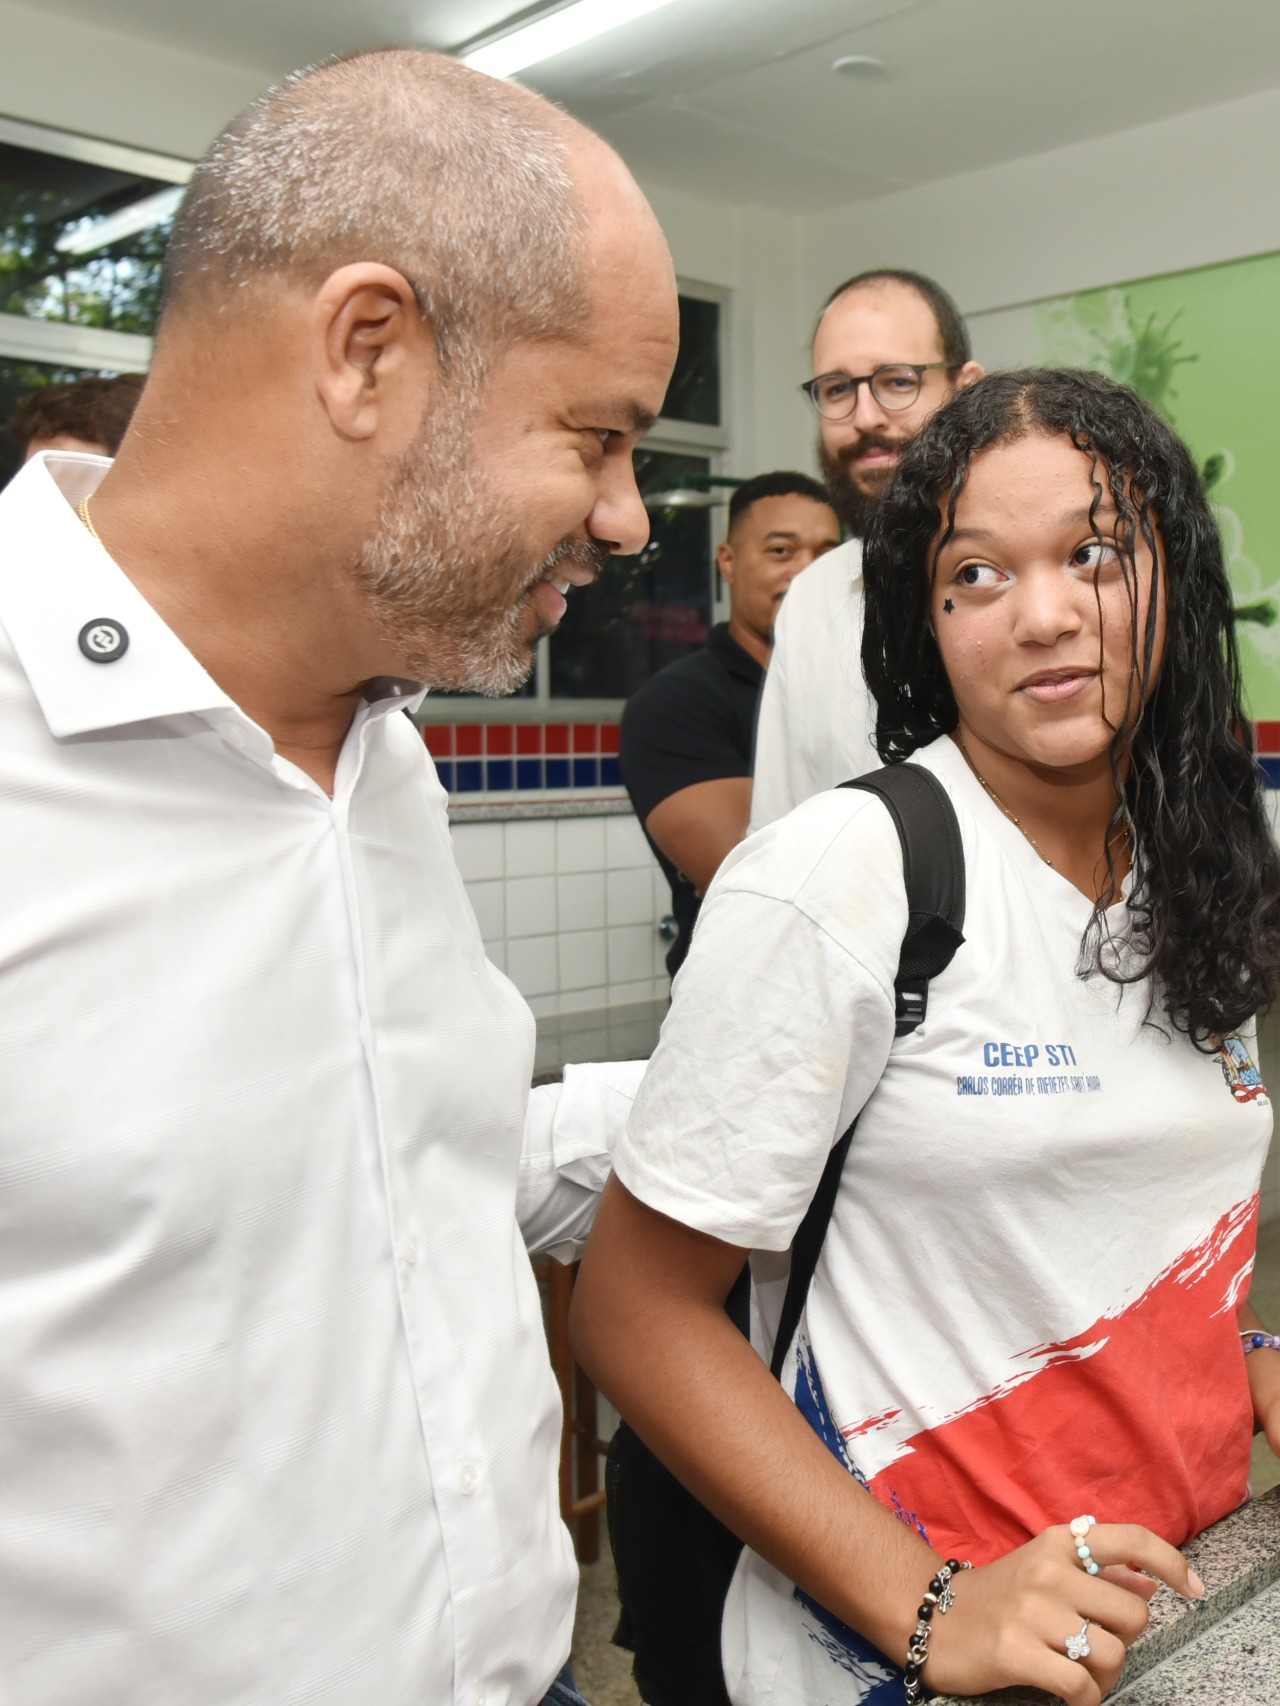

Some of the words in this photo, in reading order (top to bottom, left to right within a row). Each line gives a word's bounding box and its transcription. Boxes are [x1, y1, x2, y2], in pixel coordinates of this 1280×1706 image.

[983, 1042, 1039, 1068] CEEP
[1045, 1044, 1077, 1067] STI
[957, 1076, 988, 1096] CARLOS
[1025, 1078, 1035, 1095] DE
